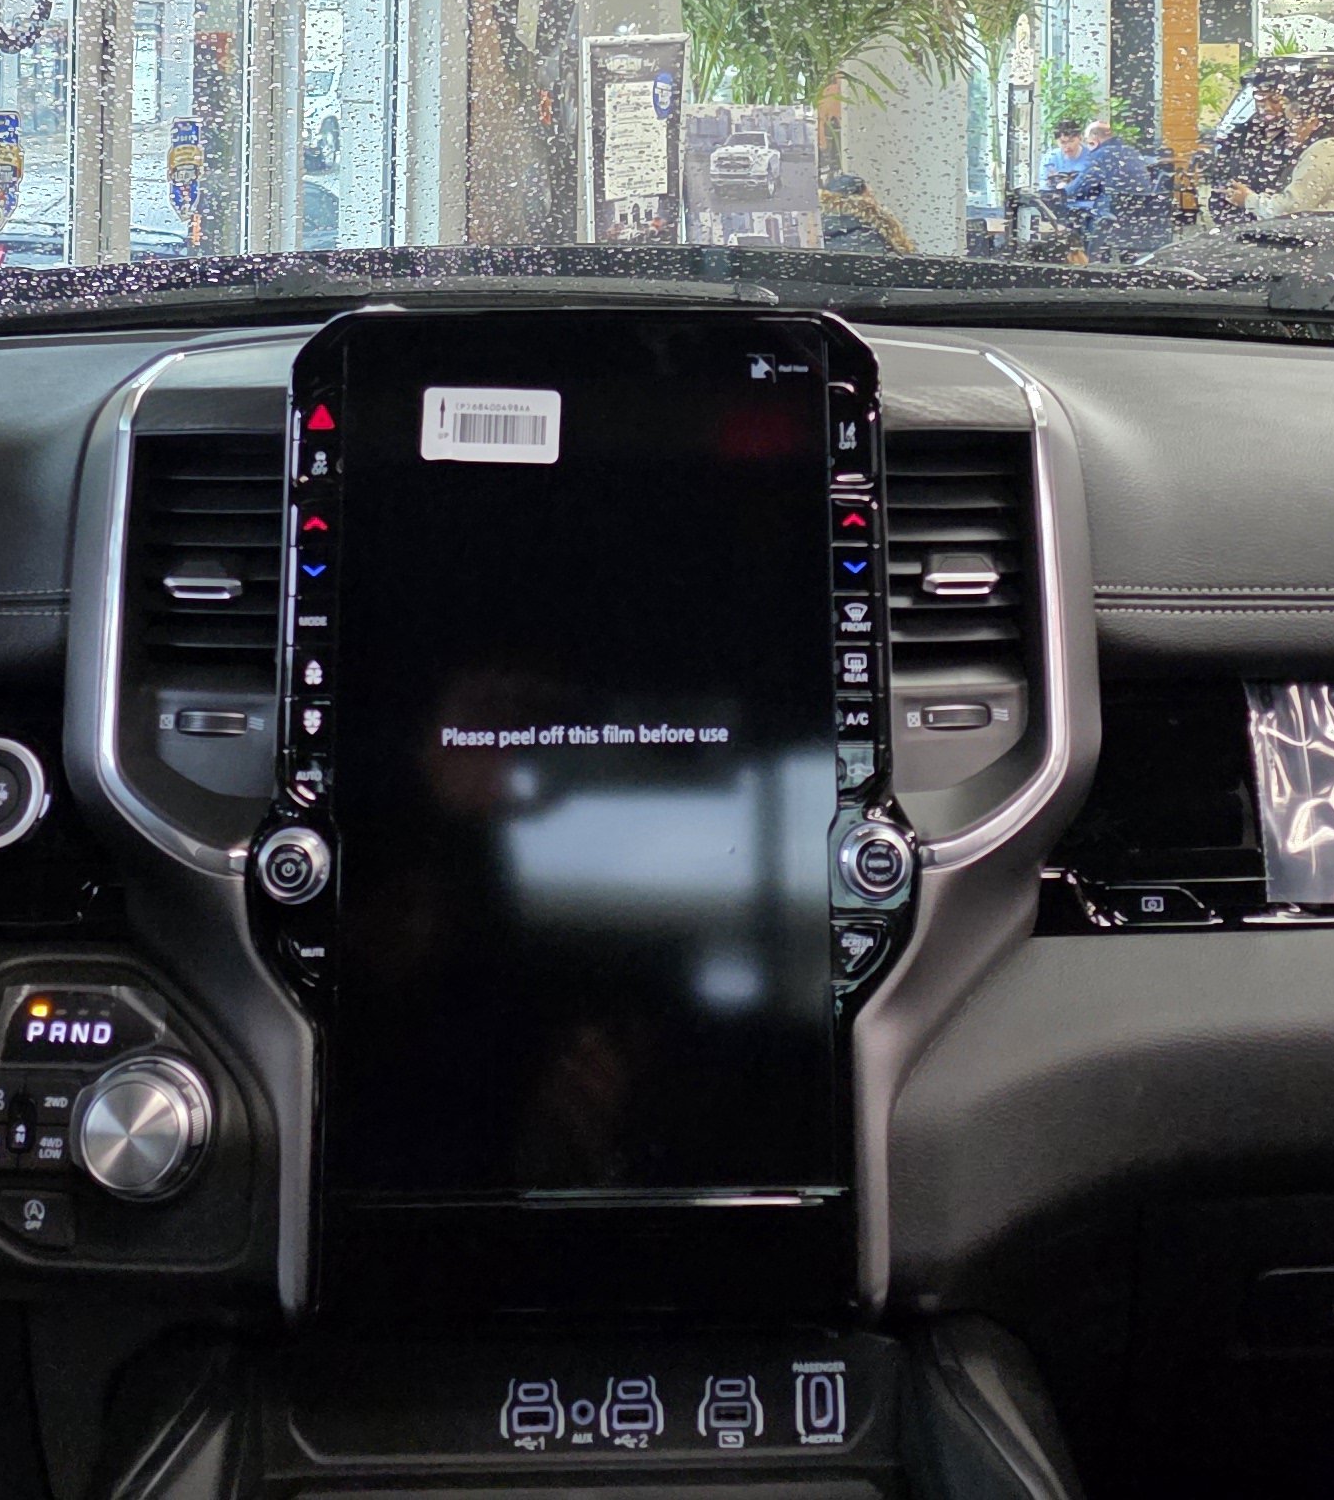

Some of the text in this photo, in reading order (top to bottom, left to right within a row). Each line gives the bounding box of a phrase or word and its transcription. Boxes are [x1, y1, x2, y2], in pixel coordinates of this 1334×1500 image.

[298, 616, 328, 626] MODE
[841, 621, 872, 632] FRONT
[843, 672, 869, 682] REAR
[845, 711, 869, 725] A/C
[441, 723, 729, 748] Please peel off this film before use
[295, 770, 323, 781] AUTO
[43, 1096, 69, 1108] 2WD
[39, 1137, 64, 1148] 4WD
[38, 1148, 63, 1160] LOW
[791, 1361, 847, 1374] PASSENGER
[538, 1436, 546, 1450] 1
[571, 1431, 594, 1444] AUX
[638, 1433, 649, 1449] 2
